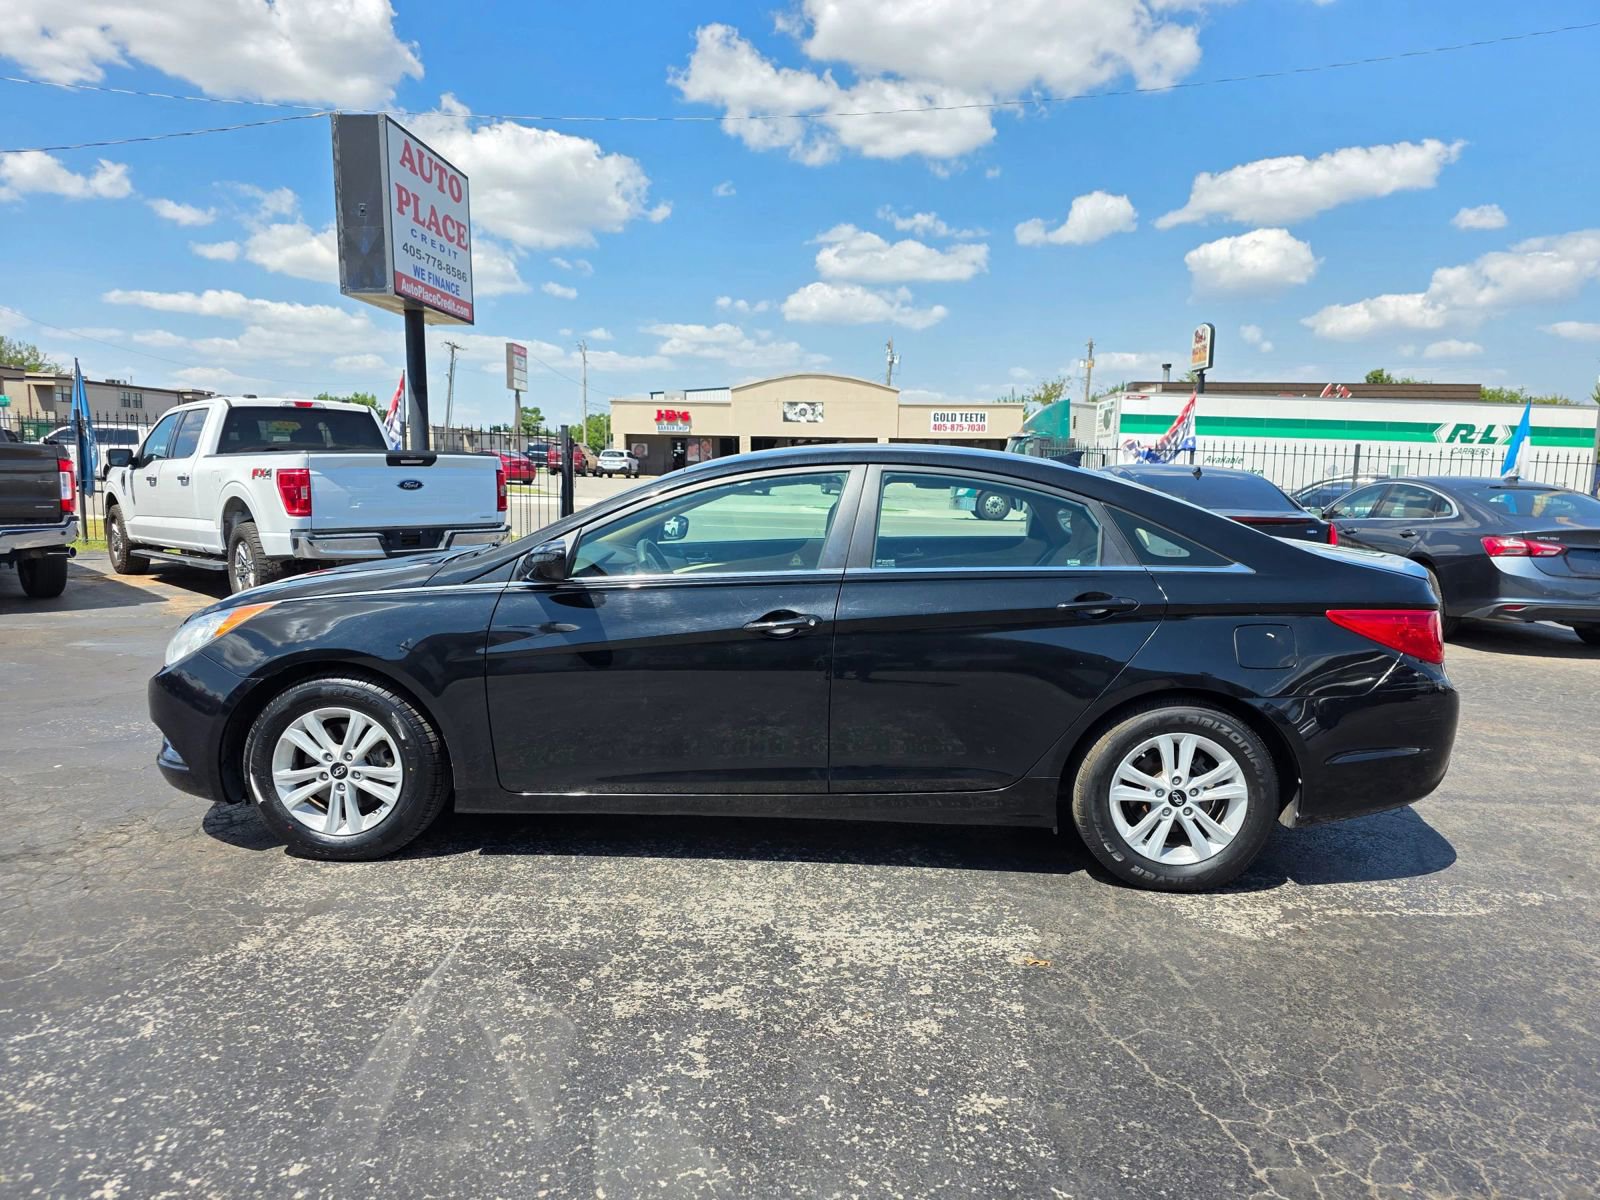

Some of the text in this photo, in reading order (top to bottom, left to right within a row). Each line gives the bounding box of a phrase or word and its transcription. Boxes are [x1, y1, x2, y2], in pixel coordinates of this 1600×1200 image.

[399, 139, 463, 204] AUTO
[395, 182, 469, 251] PLACE
[410, 228, 458, 260] CREDIT
[402, 242, 467, 283] 405-778-8586
[413, 264, 460, 297] WE FINANCE
[401, 278, 470, 317] AutoPlaceCredit.com
[932, 423, 986, 432] 405-875-7030
[933, 412, 986, 423] GOLD TEETH
[1204, 455, 1244, 465] Available
[1451, 447, 1491, 456] CARRIERS
[252, 468, 272, 480] FX4
